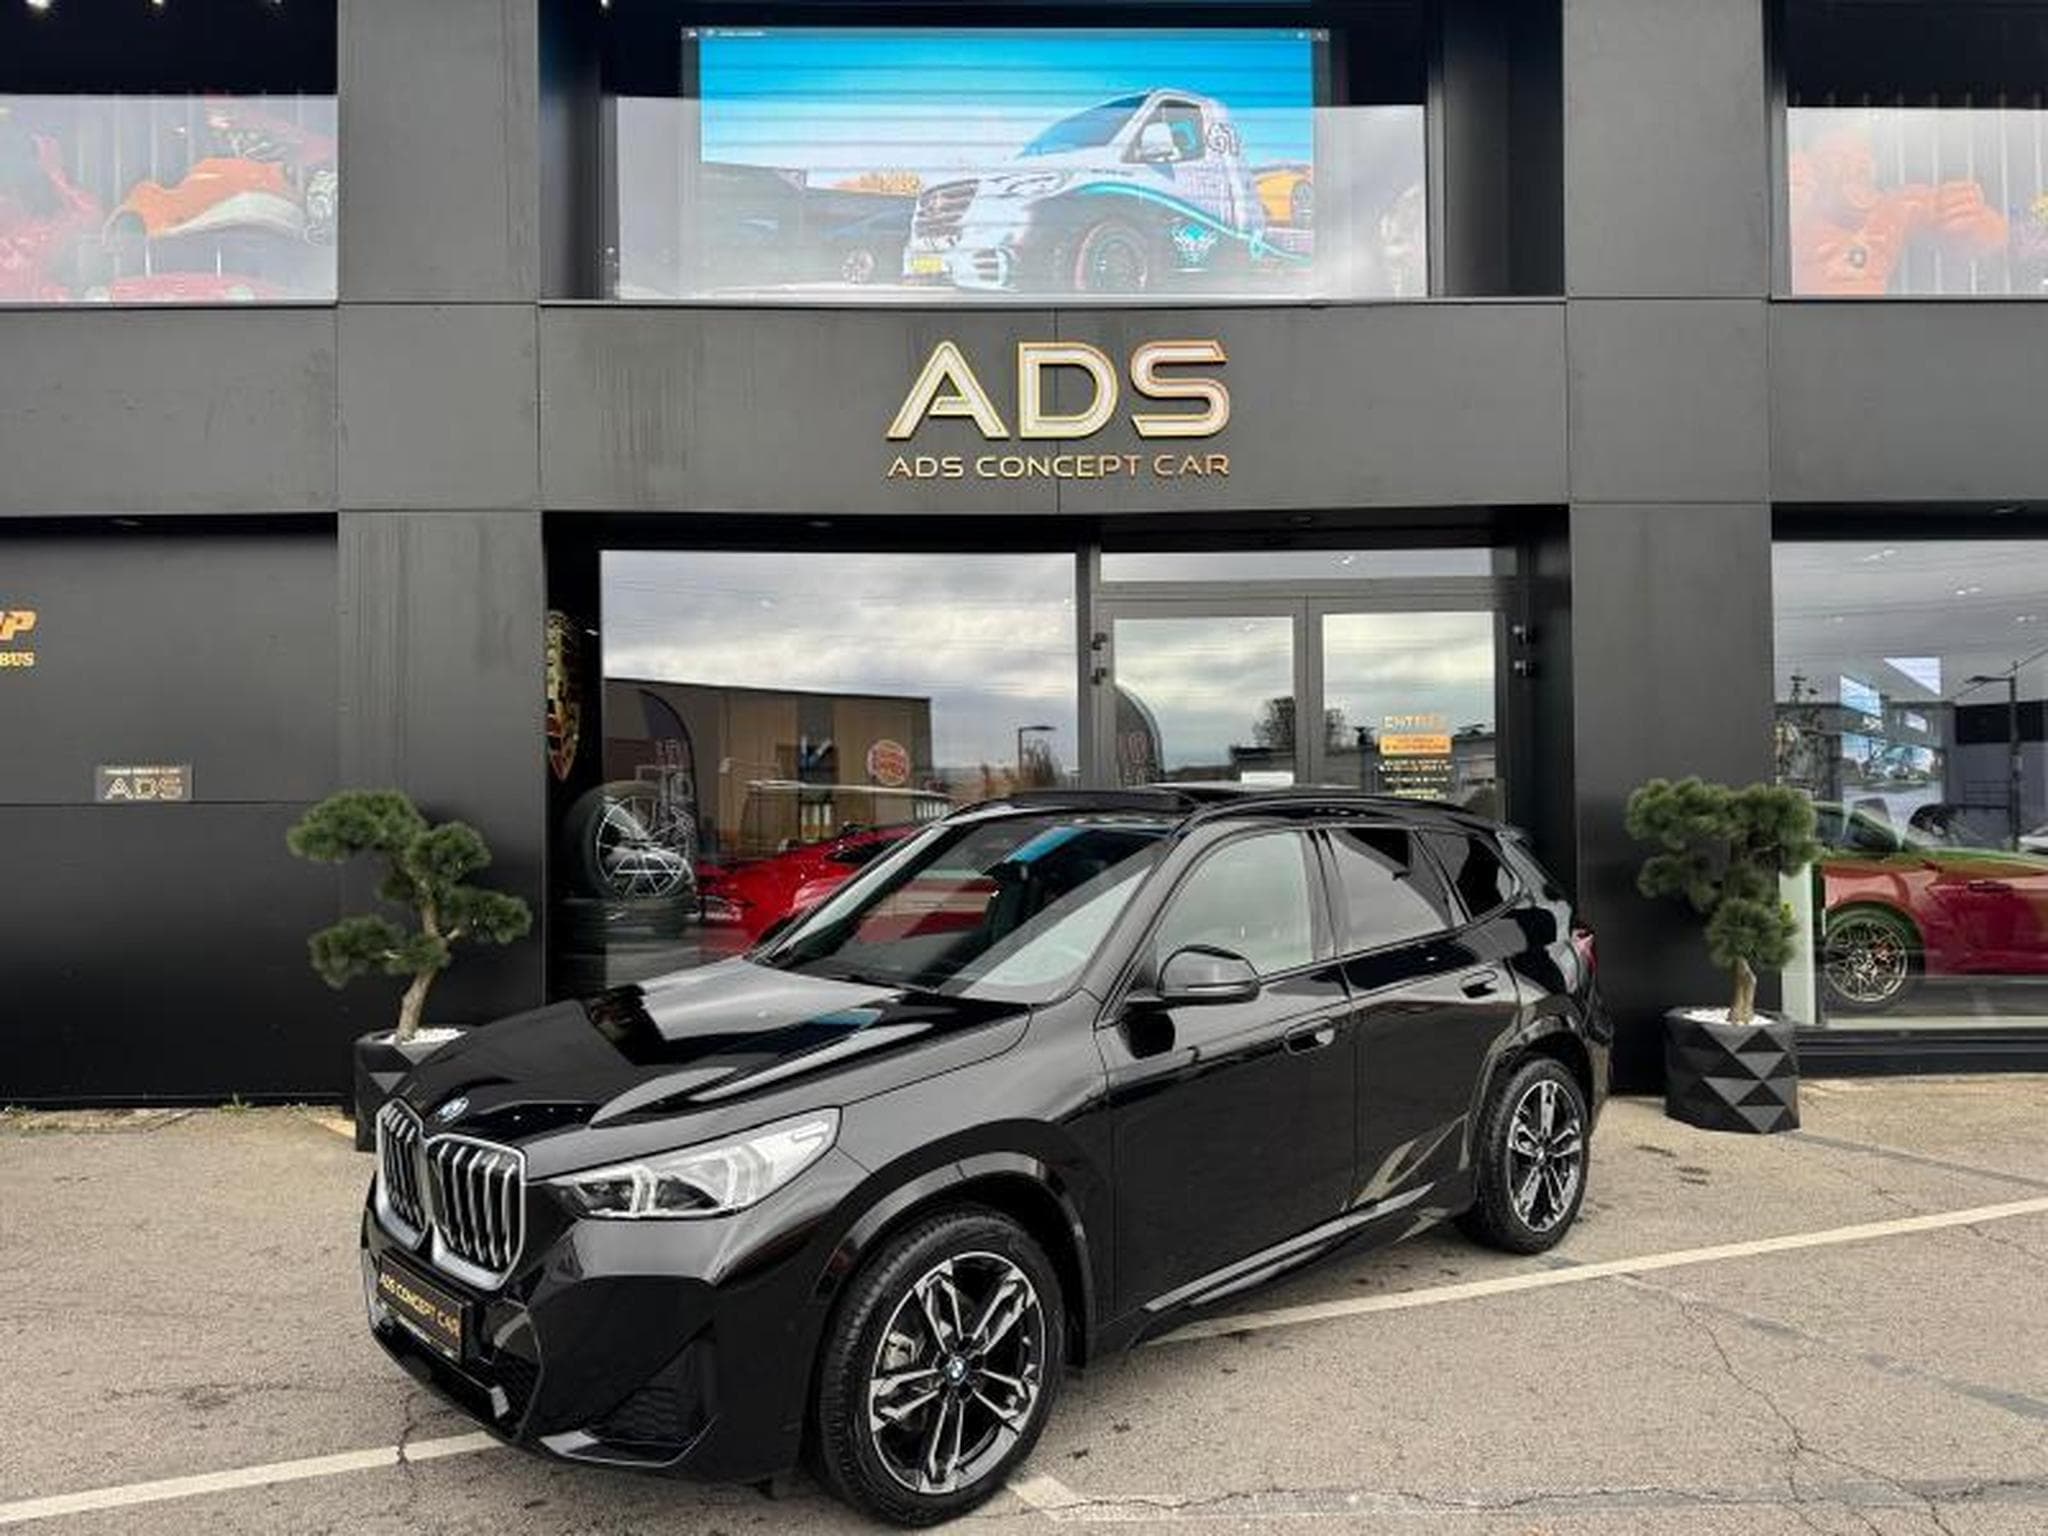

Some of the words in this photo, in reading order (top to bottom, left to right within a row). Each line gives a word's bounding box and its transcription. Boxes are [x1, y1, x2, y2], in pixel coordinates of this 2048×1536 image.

[886, 340, 1231, 440] ADS
[887, 456, 965, 479] ADS
[976, 455, 1141, 478] CONCEPT
[1153, 454, 1231, 477] CAR
[103, 777, 184, 801] ADS
